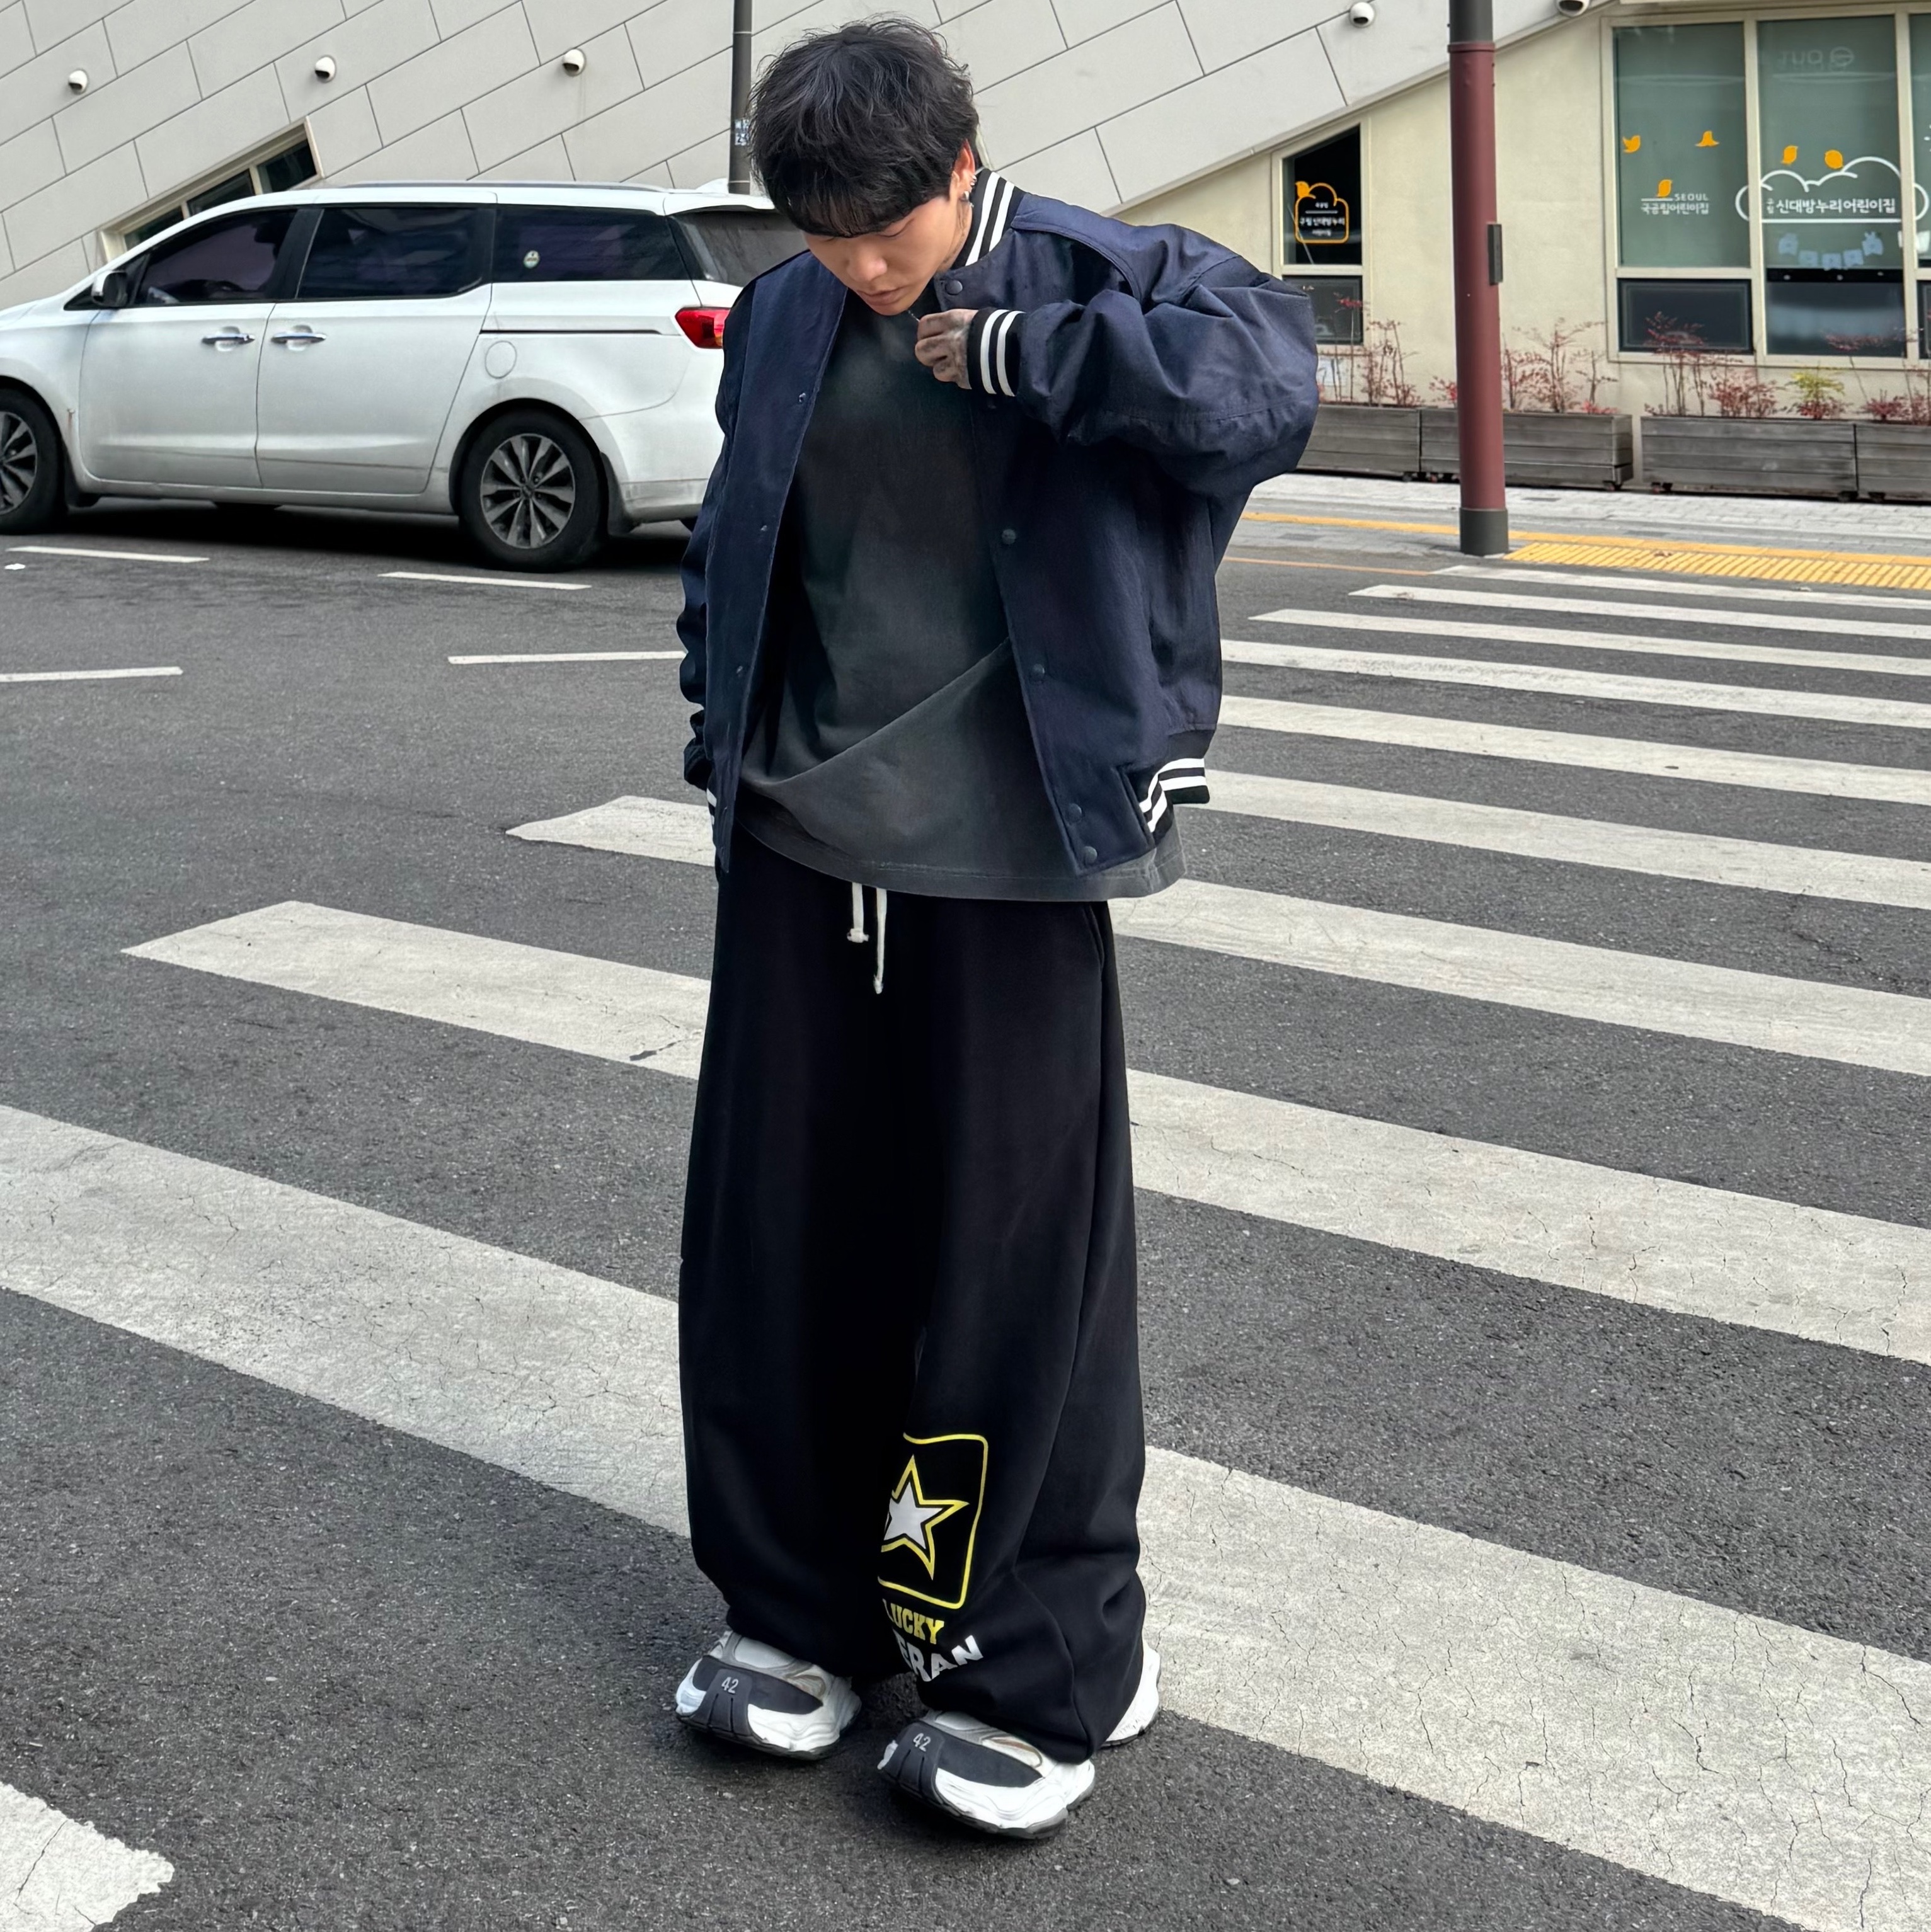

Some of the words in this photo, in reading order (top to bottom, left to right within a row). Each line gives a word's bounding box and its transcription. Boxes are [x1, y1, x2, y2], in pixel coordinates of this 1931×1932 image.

[1674, 193, 1709, 202] SEOUL
[1776, 198, 1896, 214] 신대방누리어린이집
[721, 1676, 739, 1694] 42
[913, 1733, 931, 1752] 42
